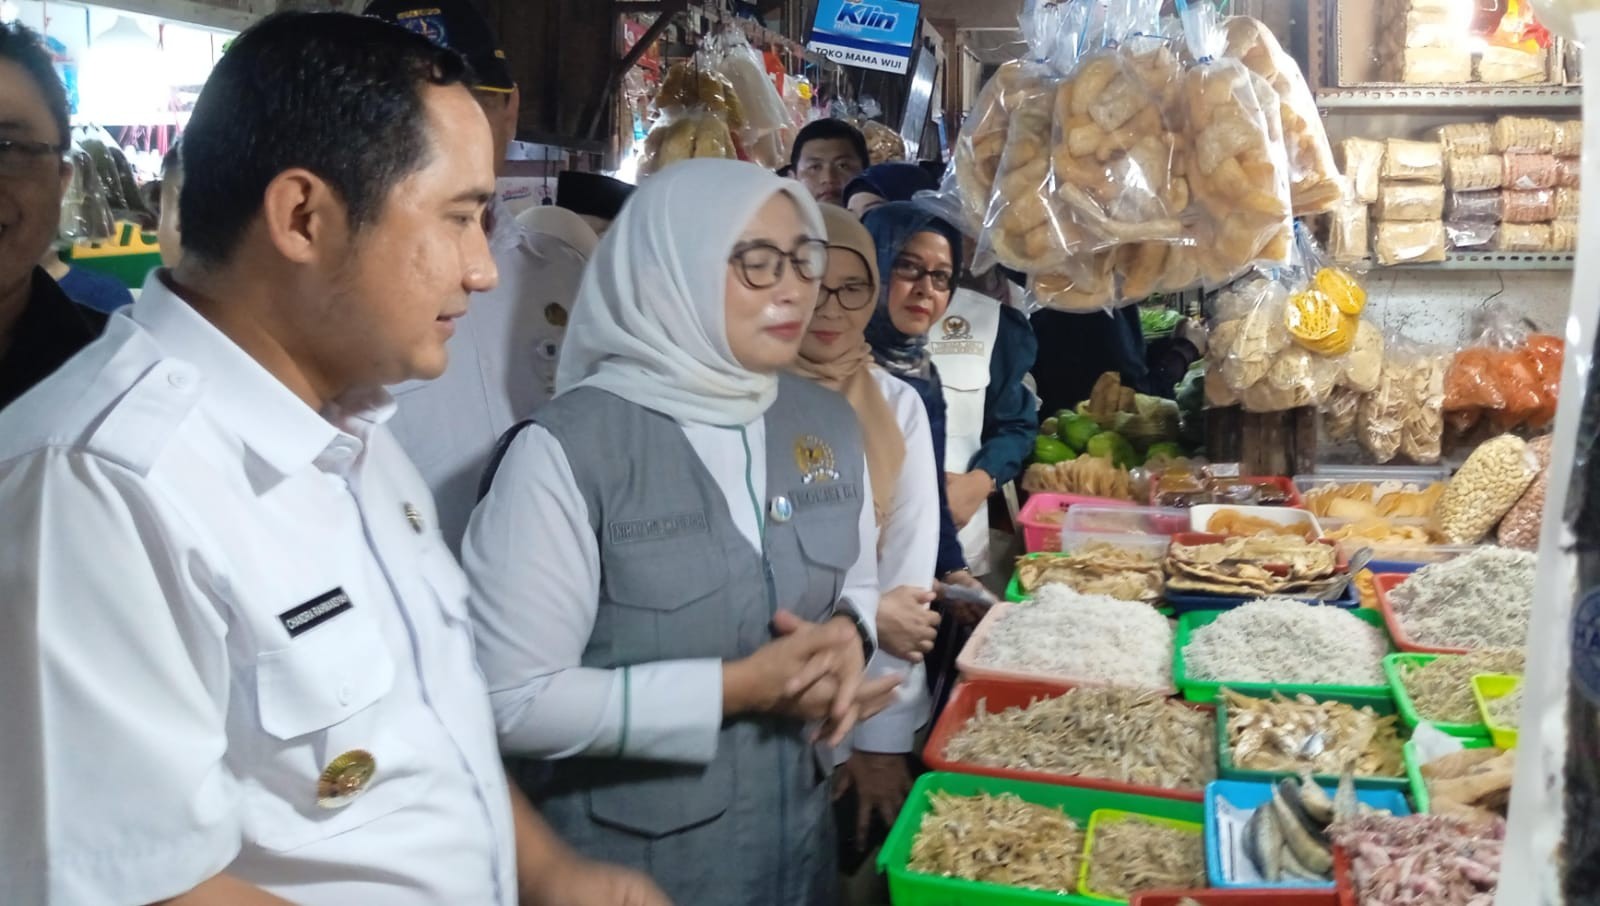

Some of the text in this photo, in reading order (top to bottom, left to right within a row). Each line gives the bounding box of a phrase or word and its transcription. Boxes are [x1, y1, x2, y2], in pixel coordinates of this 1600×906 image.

[835, 1, 898, 31] Klin
[815, 47, 843, 59] TOKO
[845, 53, 878, 65] MAMA
[286, 609, 316, 630] CHANDRA
